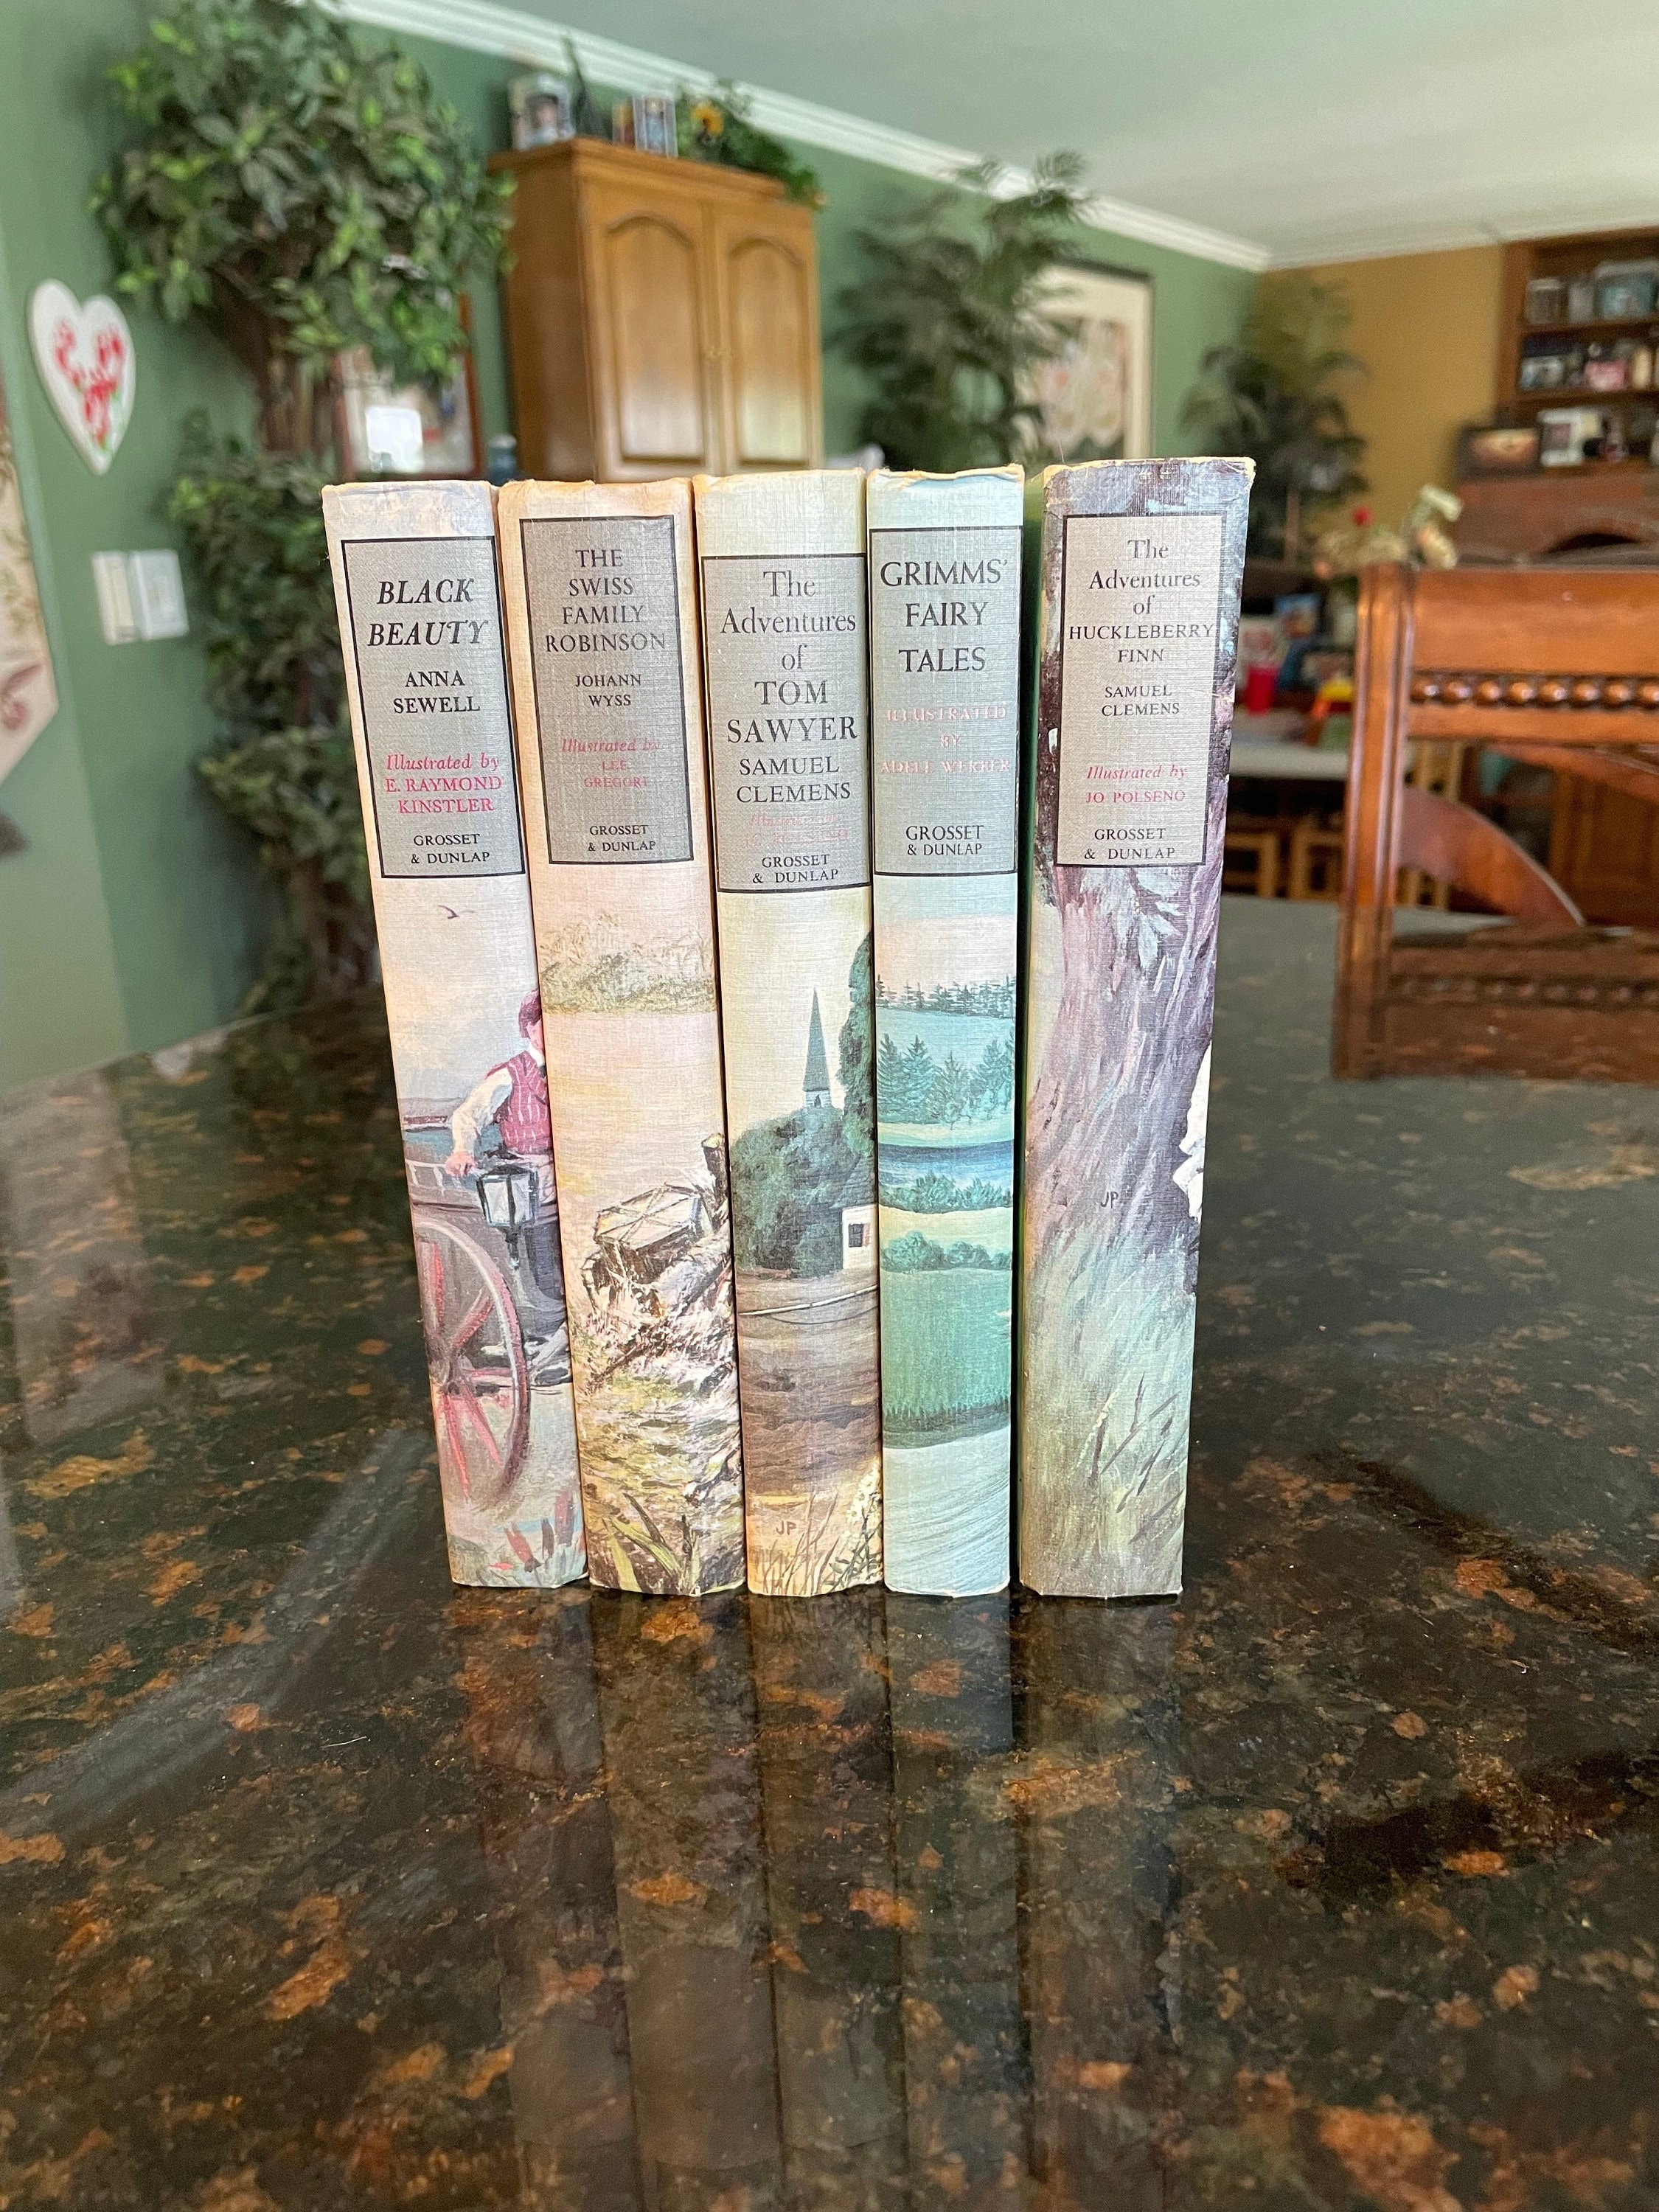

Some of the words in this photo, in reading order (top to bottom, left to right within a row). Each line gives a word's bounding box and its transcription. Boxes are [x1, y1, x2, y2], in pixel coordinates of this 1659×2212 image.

[1127, 539, 1169, 560] The
[575, 549, 623, 568] THE
[880, 559, 1007, 586] GRIMMS'
[1089, 569, 1200, 590] Adventures
[377, 578, 474, 604] BLACK
[569, 577, 633, 597] SWISS
[762, 571, 815, 598] The
[1133, 595, 1156, 615] of
[563, 605, 644, 625] FAMILY
[720, 607, 856, 634] Adventures
[905, 602, 988, 627] FAIRY
[368, 619, 488, 647] BEAUTY
[1069, 624, 1214, 640] HUCKLEBERRY
[546, 633, 665, 653] ROBINSON
[782, 644, 807, 670] of
[898, 647, 986, 672] TALES
[1118, 649, 1164, 663] FINN
[405, 670, 465, 687] ANNA
[575, 674, 641, 687] JOHANN
[754, 679, 828, 706] TOM
[1105, 686, 1172, 698] SAMUEL
[393, 697, 480, 714] SEWELL
[588, 695, 631, 707] WYSS
[888, 706, 1007, 722] ILLUSTRATED
[1102, 703, 1180, 717] CLEMENS
[727, 716, 858, 743] SAWYER
[562, 738, 636, 752] Illustrated
[386, 754, 472, 771] Illustrated
[481, 753, 499, 771] by
[602, 760, 627, 771] LEE
[740, 756, 839, 776] SAMUEL
[1087, 765, 1162, 780] Illustrated
[1169, 765, 1186, 781] by
[386, 778, 400, 792] E.
[406, 776, 502, 792] RAYMOND
[737, 782, 850, 803] CLEMENS
[1085, 791, 1105, 804] JO
[1113, 790, 1186, 804] POLSENO
[398, 799, 494, 814] KINSTLER
[589, 824, 648, 835] GROSSET
[905, 824, 984, 841] GROSSET
[1094, 827, 1166, 841] GROSSET
[414, 833, 480, 846] GROSSET
[588, 841, 596, 852] &
[603, 841, 656, 852] DUNLAP
[411, 853, 420, 864] &
[428, 852, 490, 864] DUNLAP
[907, 845, 917, 855] &
[923, 844, 983, 855] DUNLAP
[1084, 849, 1095, 860] &
[1108, 846, 1175, 860] DUNLAP
[762, 854, 830, 868] GROSSET
[753, 873, 764, 883] &
[776, 869, 838, 883] DUNLAP
[1100, 1191, 1119, 1209] JP
[776, 1520, 796, 1535] JP
